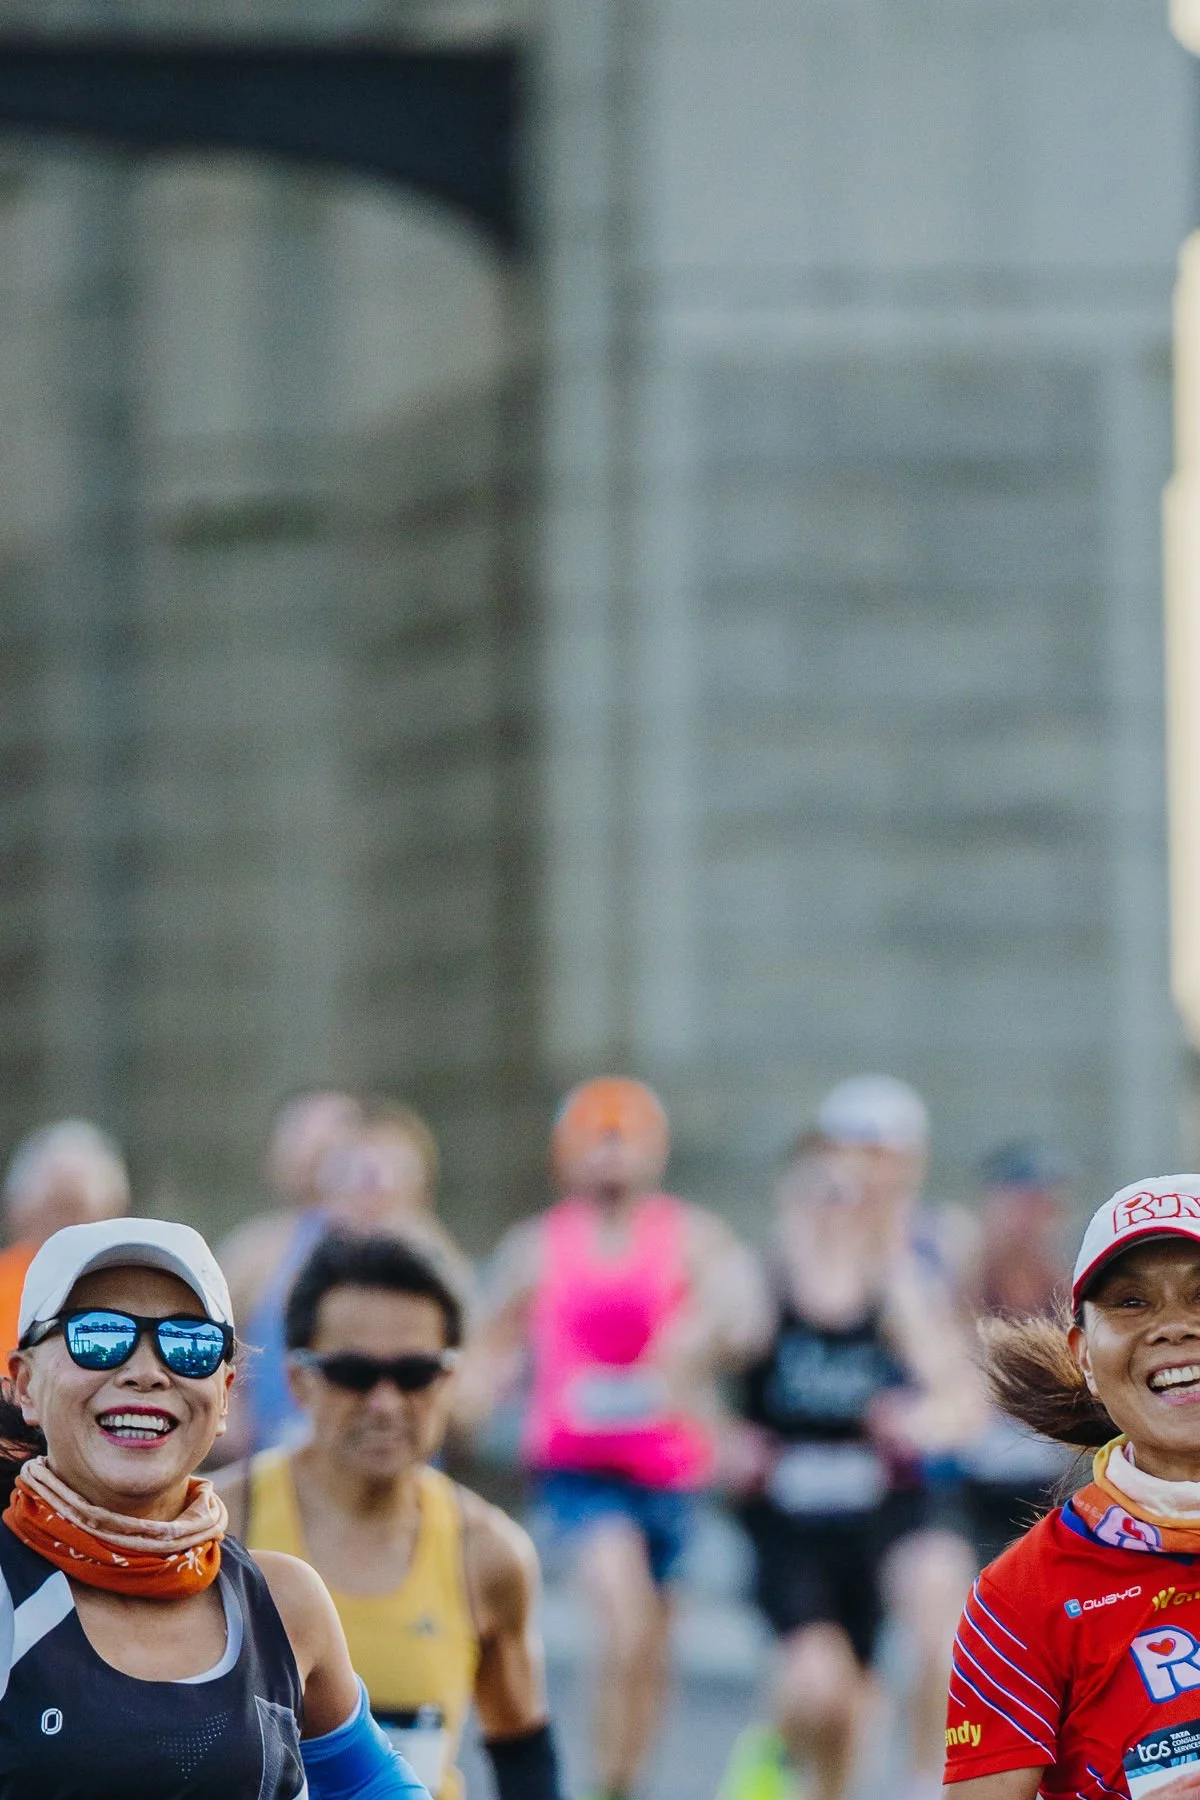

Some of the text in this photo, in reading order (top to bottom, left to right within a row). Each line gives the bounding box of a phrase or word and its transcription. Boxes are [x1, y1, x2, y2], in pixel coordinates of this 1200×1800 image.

[945, 1720, 981, 1747] ndy
[1170, 1730, 1191, 1741] TATA
[1137, 1740, 1171, 1762] tcs
